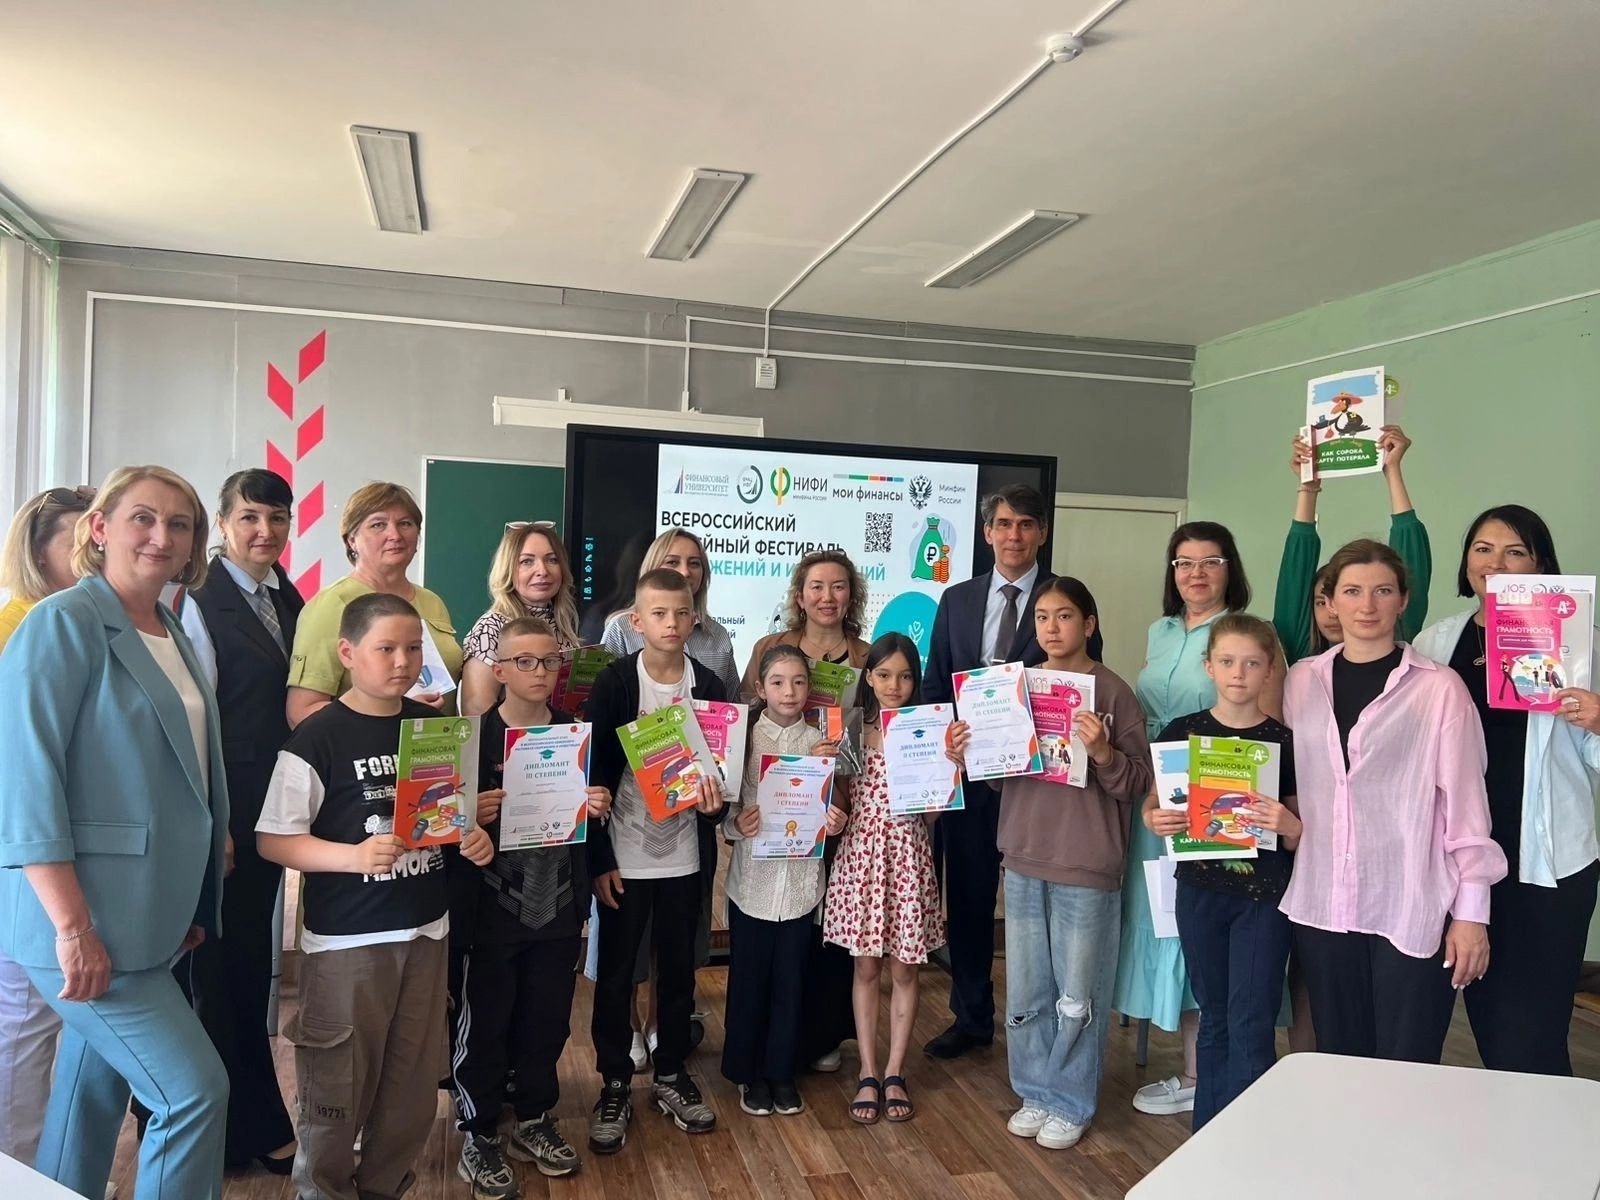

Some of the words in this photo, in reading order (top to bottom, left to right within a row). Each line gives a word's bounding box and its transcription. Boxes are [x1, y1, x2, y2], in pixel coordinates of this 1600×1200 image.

[1336, 448, 1363, 456] СОРОКА
[1336, 454, 1370, 462] ПОТЕРЯЛА
[685, 473, 729, 484] ФИНАНСОВЫЙ
[685, 483, 728, 492] УНИВЕРСИТЕТ
[793, 476, 828, 492] НИФИ
[939, 484, 966, 493] Минфин
[832, 488, 854, 499] мои
[856, 486, 903, 502] финансы
[938, 496, 962, 504] России
[661, 511, 796, 532] ВСЕРОССИЙСКИЙ
[699, 534, 749, 554] ЙНЫЙ
[711, 558, 765, 577] ЖЕНИЙ
[771, 562, 781, 577] И
[712, 615, 745, 625] альный
[1496, 626, 1554, 634] ГРАМОТНОСТЬ
[635, 728, 677, 750] ФИНАНСОВАЯ
[411, 745, 456, 755] ФИНАНСОВАЯ
[637, 735, 680, 757] ГРАМОТНОСТЬ
[410, 754, 455, 764] ГРАМОТНОСТЬ
[523, 761, 571, 771] ДИПЛОМАНТ
[1200, 761, 1251, 770] ФИНАНСОВАЯ
[535, 770, 567, 779] СТЕПЕНИ
[1199, 768, 1251, 777] ГРАМОТНОСТЬ
[773, 791, 813, 799] ДИПЛОМАНТ
